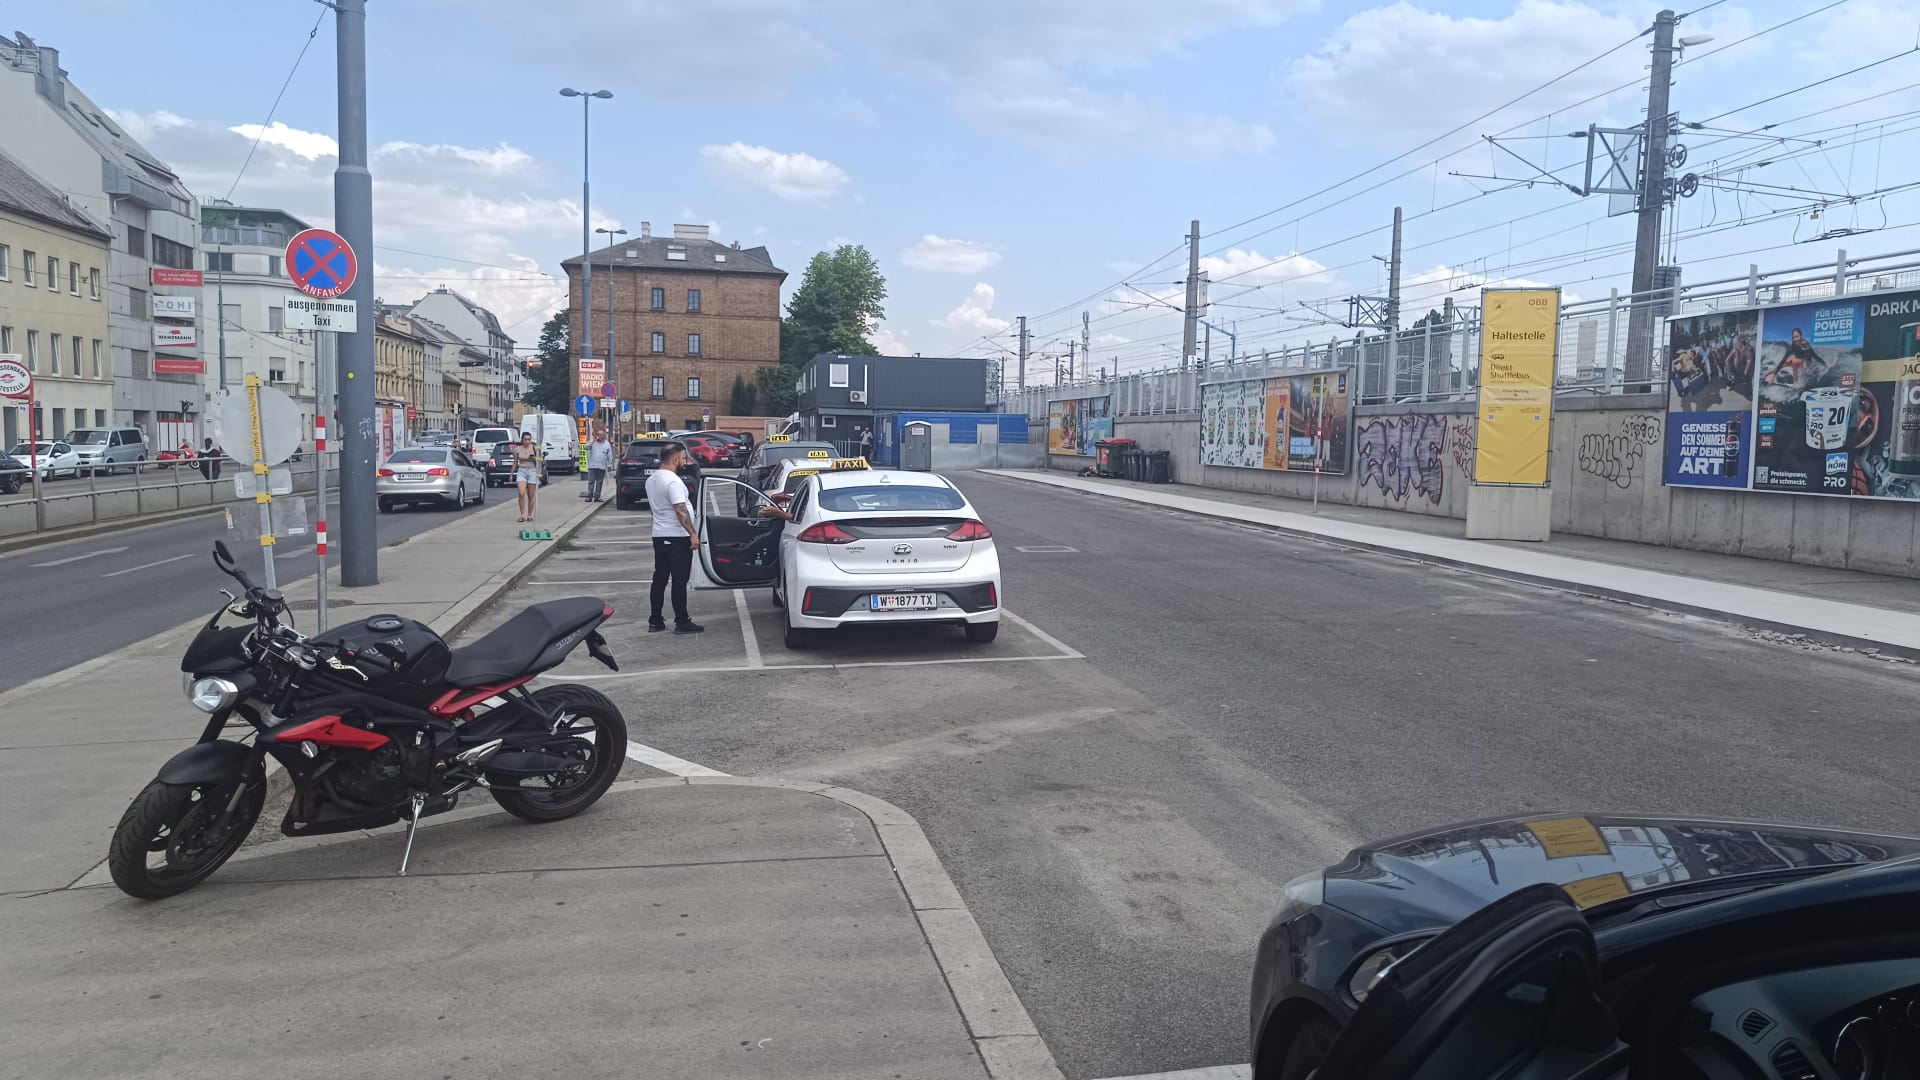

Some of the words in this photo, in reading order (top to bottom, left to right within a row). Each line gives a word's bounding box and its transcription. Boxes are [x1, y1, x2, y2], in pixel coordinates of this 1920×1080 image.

[303, 283, 342, 297] ANFANG
[287, 300, 354, 313] ausgenommen
[1871, 301, 1910, 317] DARK
[1912, 299, 1920, 313] M
[1815, 308, 1831, 319] FÜR
[1831, 307, 1854, 317] MEHR
[313, 315, 331, 327] Taxi
[1814, 318, 1853, 332] POWER
[1492, 331, 1546, 341] Haltestelle
[0, 364, 27, 378] SSENBAHN
[1489, 371, 1531, 380] Shuttlebus
[1902, 363, 1920, 377] JAC
[580, 373, 604, 381] RADIO
[581, 380, 604, 388] WIEN
[1827, 406, 1846, 426] 20
[1681, 423, 1727, 433] GENIESS
[1681, 433, 1696, 446] DEN
[1696, 434, 1726, 446] SOMMER
[1680, 446, 1699, 457] AUF
[1699, 447, 1725, 457] DEINE
[837, 460, 863, 469] TAXI
[1678, 457, 1725, 475] ART
[1770, 470, 1808, 479] Proteinpower,
[1823, 476, 1847, 488] PRO
[895, 595, 918, 606] 1877
[920, 595, 933, 605] TX
